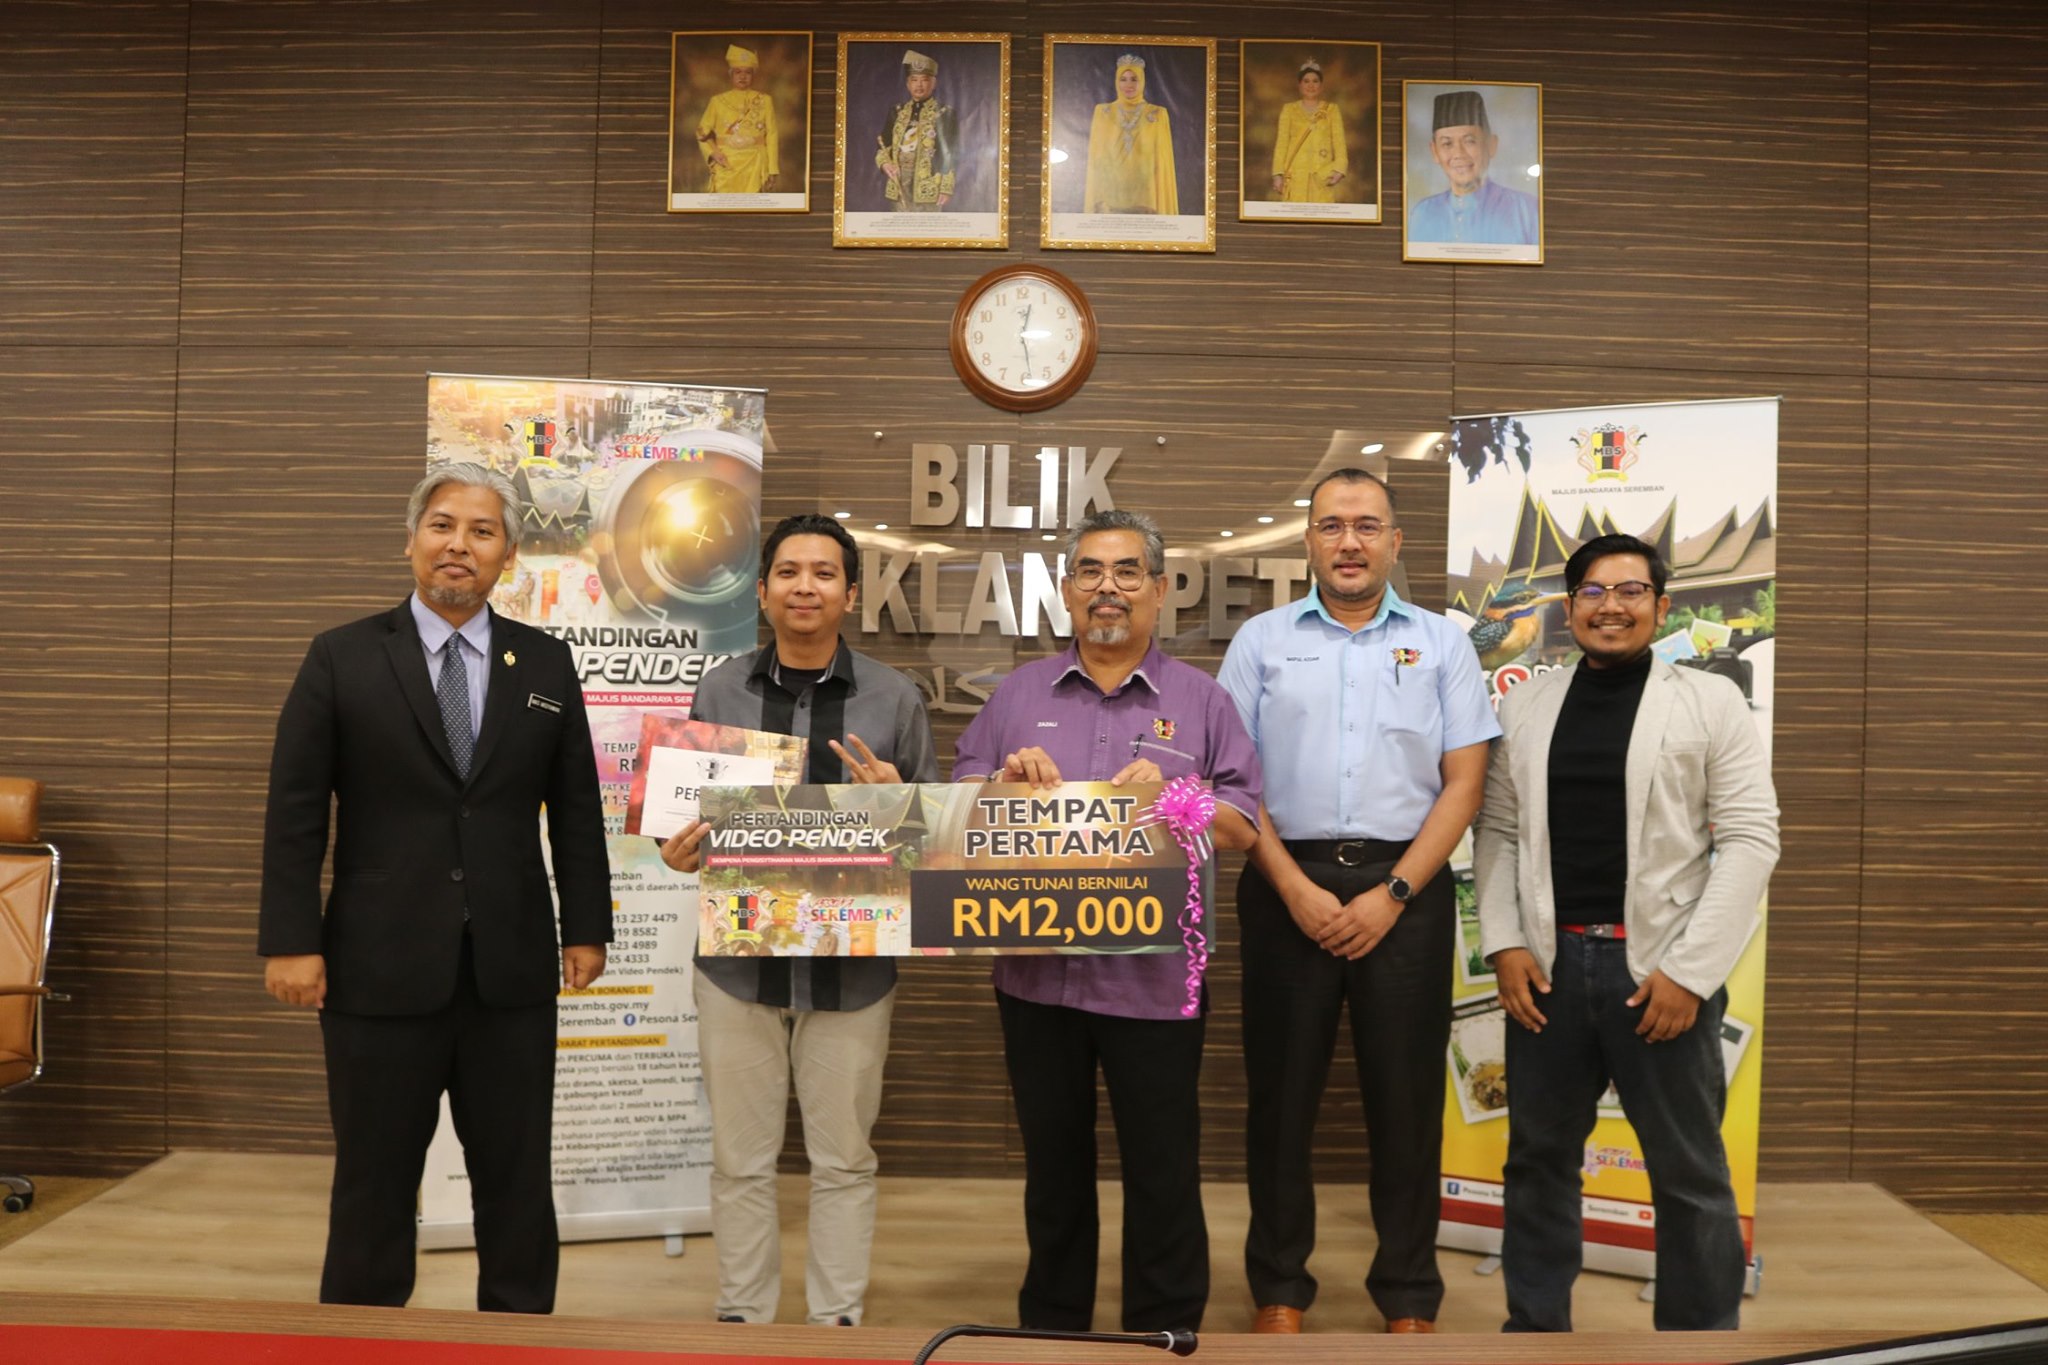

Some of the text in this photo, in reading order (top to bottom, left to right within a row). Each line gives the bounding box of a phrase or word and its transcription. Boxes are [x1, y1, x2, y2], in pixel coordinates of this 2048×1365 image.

[1016, 287, 1029, 299] 12
[1042, 292, 1047, 304] 1
[995, 293, 1007, 306] 11
[980, 310, 992, 323] 10
[1056, 307, 1066, 319] 2
[973, 332, 984, 344] 9
[1065, 329, 1074, 341] 3
[982, 353, 991, 366] 8
[1057, 351, 1067, 363] 4
[1000, 367, 1008, 381] 7
[1043, 367, 1051, 380] 5
[526, 435, 553, 444] MBS
[614, 445, 704, 462] SEREMBAN
[1593, 446, 1622, 456] MBS
[911, 443, 1123, 529] BILIK
[1623, 485, 1665, 493] SEREMBAN
[533, 626, 698, 649] TANDINGAN
[586, 694, 619, 703] MAJLIS
[621, 695, 673, 704] BANDARAYA
[978, 797, 1137, 825] TEMPAT
[730, 811, 869, 826] PERTANDINGAN
[708, 829, 891, 848] VIDEO PENDEK
[964, 829, 1153, 857] PERTAMA
[647, 882, 679, 891] daerah
[965, 876, 1148, 891] WANG TUNAI BERNILAI
[630, 914, 649, 923] 237
[652, 913, 678, 923] 4479
[730, 909, 756, 917] MBS
[811, 908, 899, 922] SEREMBAN
[953, 896, 1163, 944] RM2,000
[632, 927, 658, 936] 8582
[632, 940, 658, 950] 4989
[624, 953, 650, 963] 4333
[619, 965, 645, 975] Video
[560, 1016, 616, 1026] Seremban
[639, 1014, 679, 1024] Pesona
[589, 1036, 661, 1047] PERTANDINGAN
[568, 1054, 613, 1063] PERCUMA
[634, 1051, 674, 1060] TERBUKA
